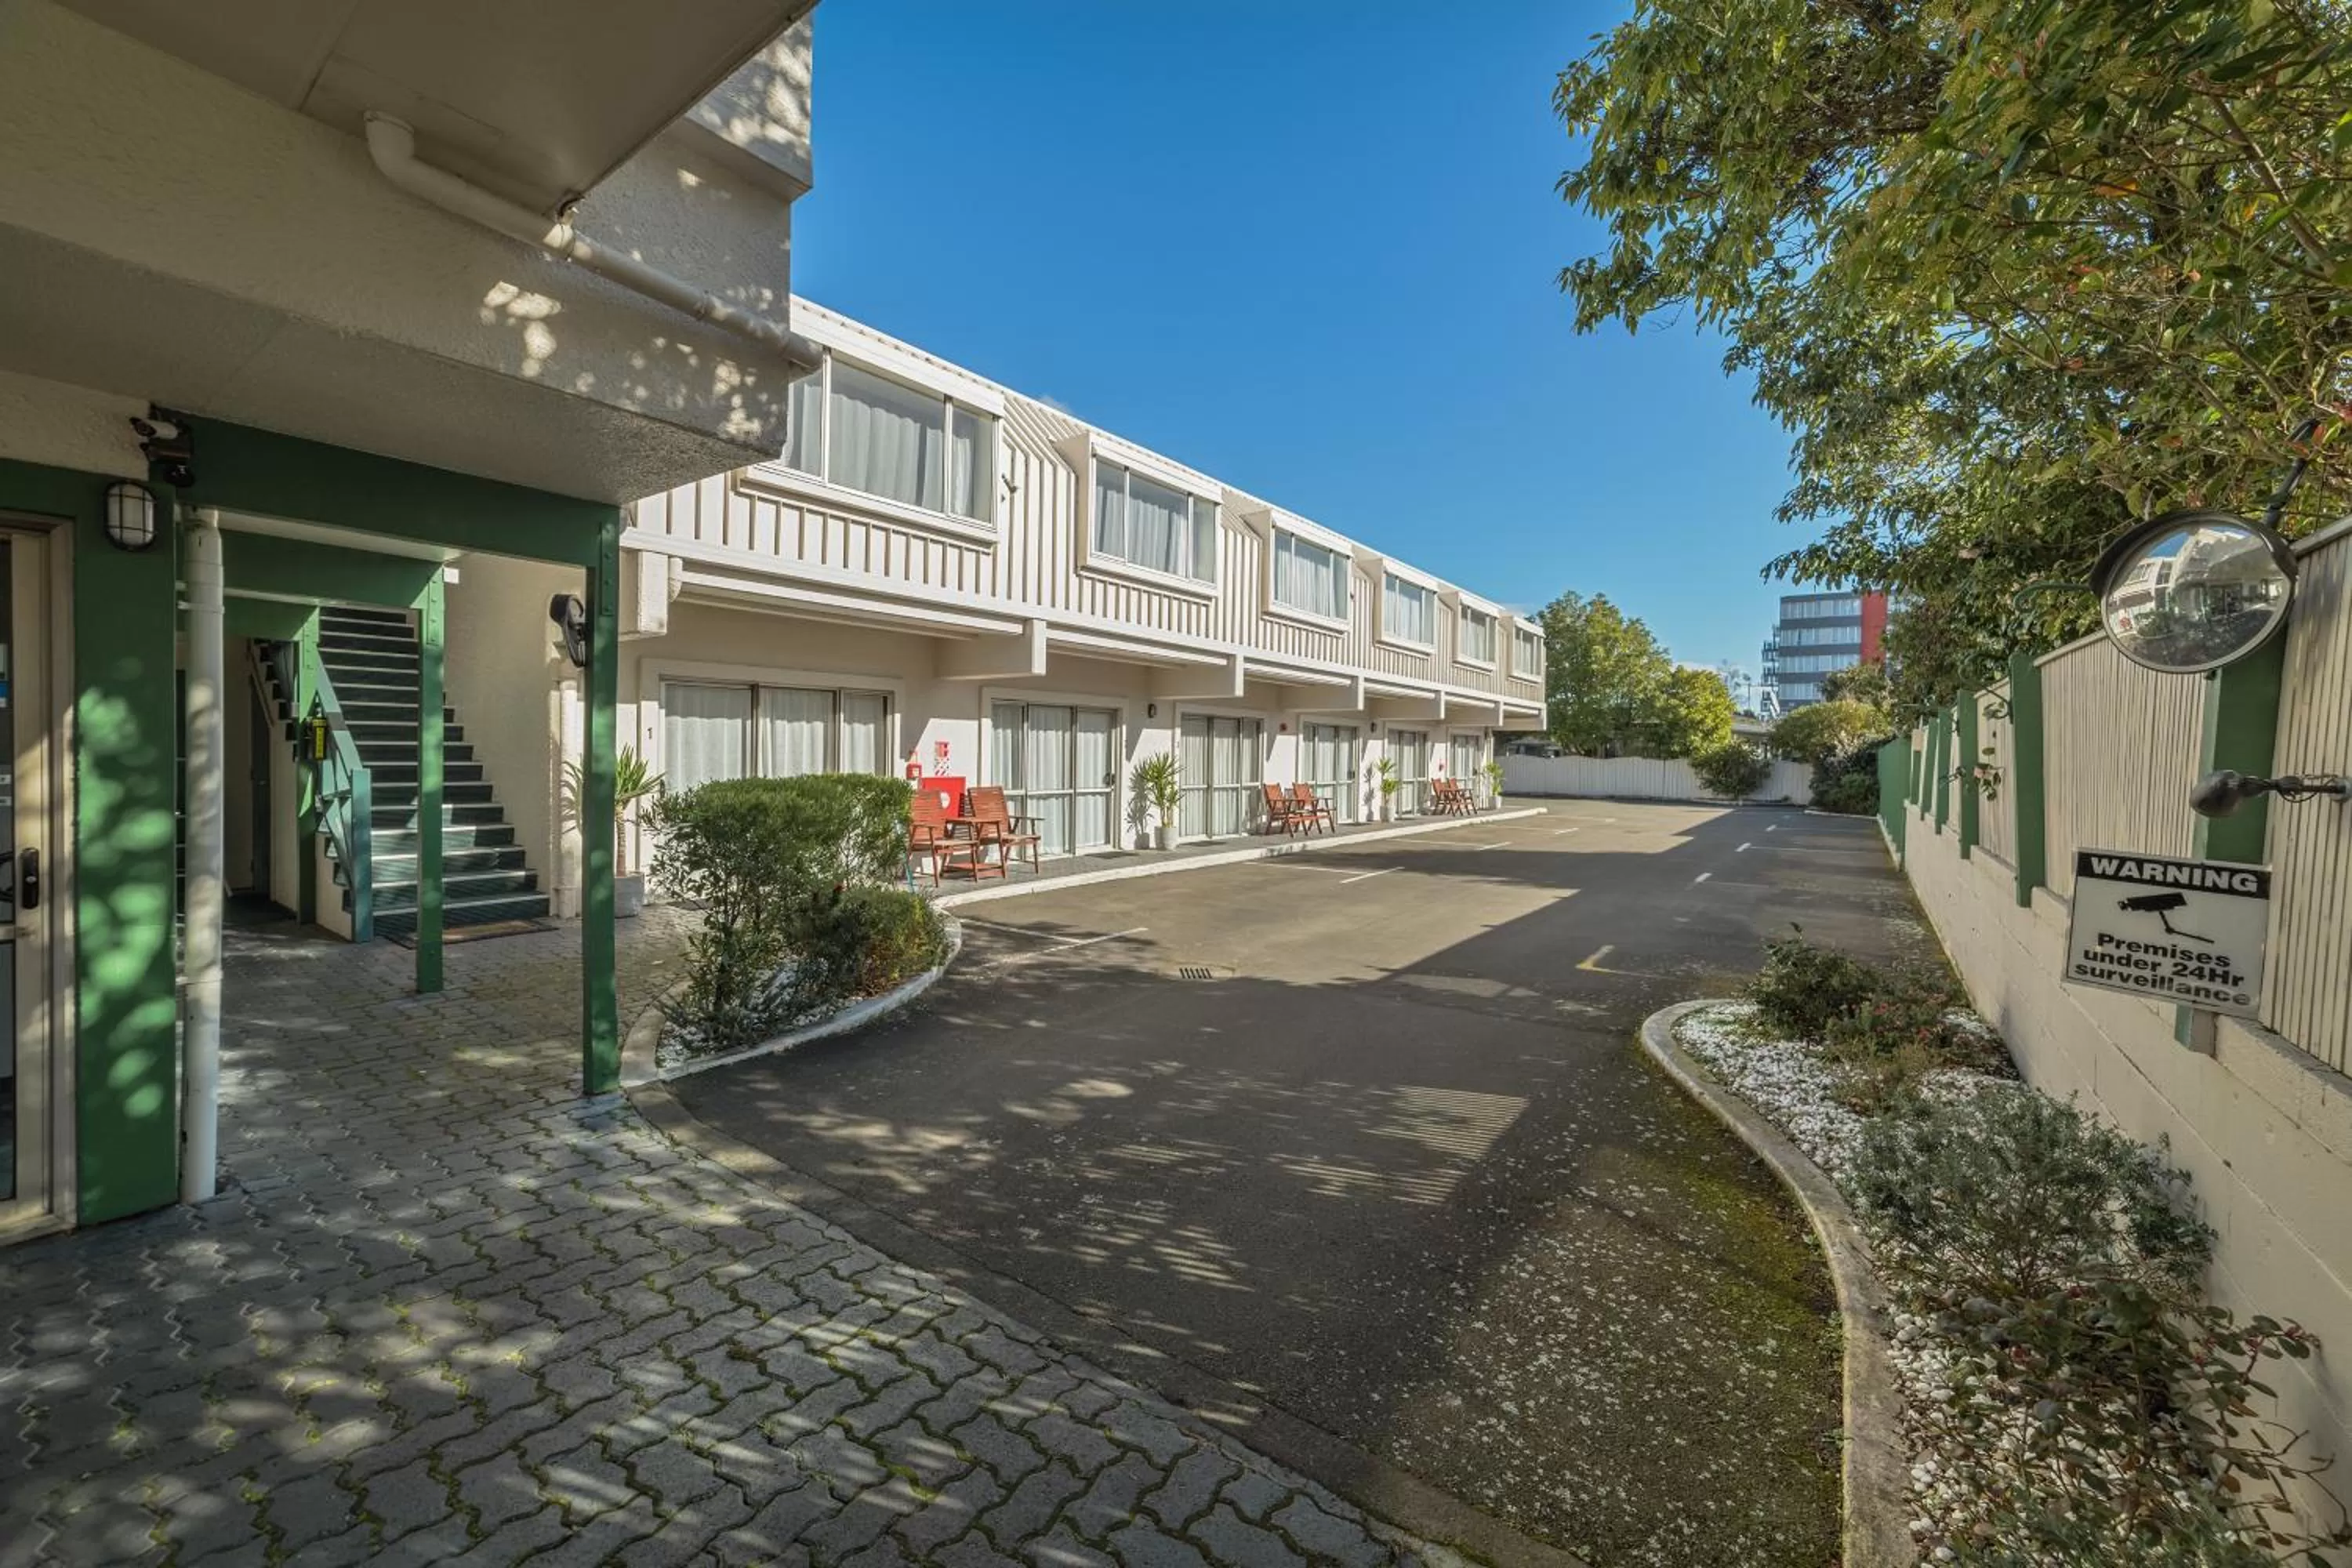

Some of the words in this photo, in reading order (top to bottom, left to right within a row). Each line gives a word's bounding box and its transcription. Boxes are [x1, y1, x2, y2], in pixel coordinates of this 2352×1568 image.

[2091, 857, 2258, 893] WARNING
[2083, 949, 2162, 973] under
[2172, 962, 2245, 987] 24Hr
[2096, 932, 2231, 967] Premises
[2074, 964, 2251, 1006] surveillance
